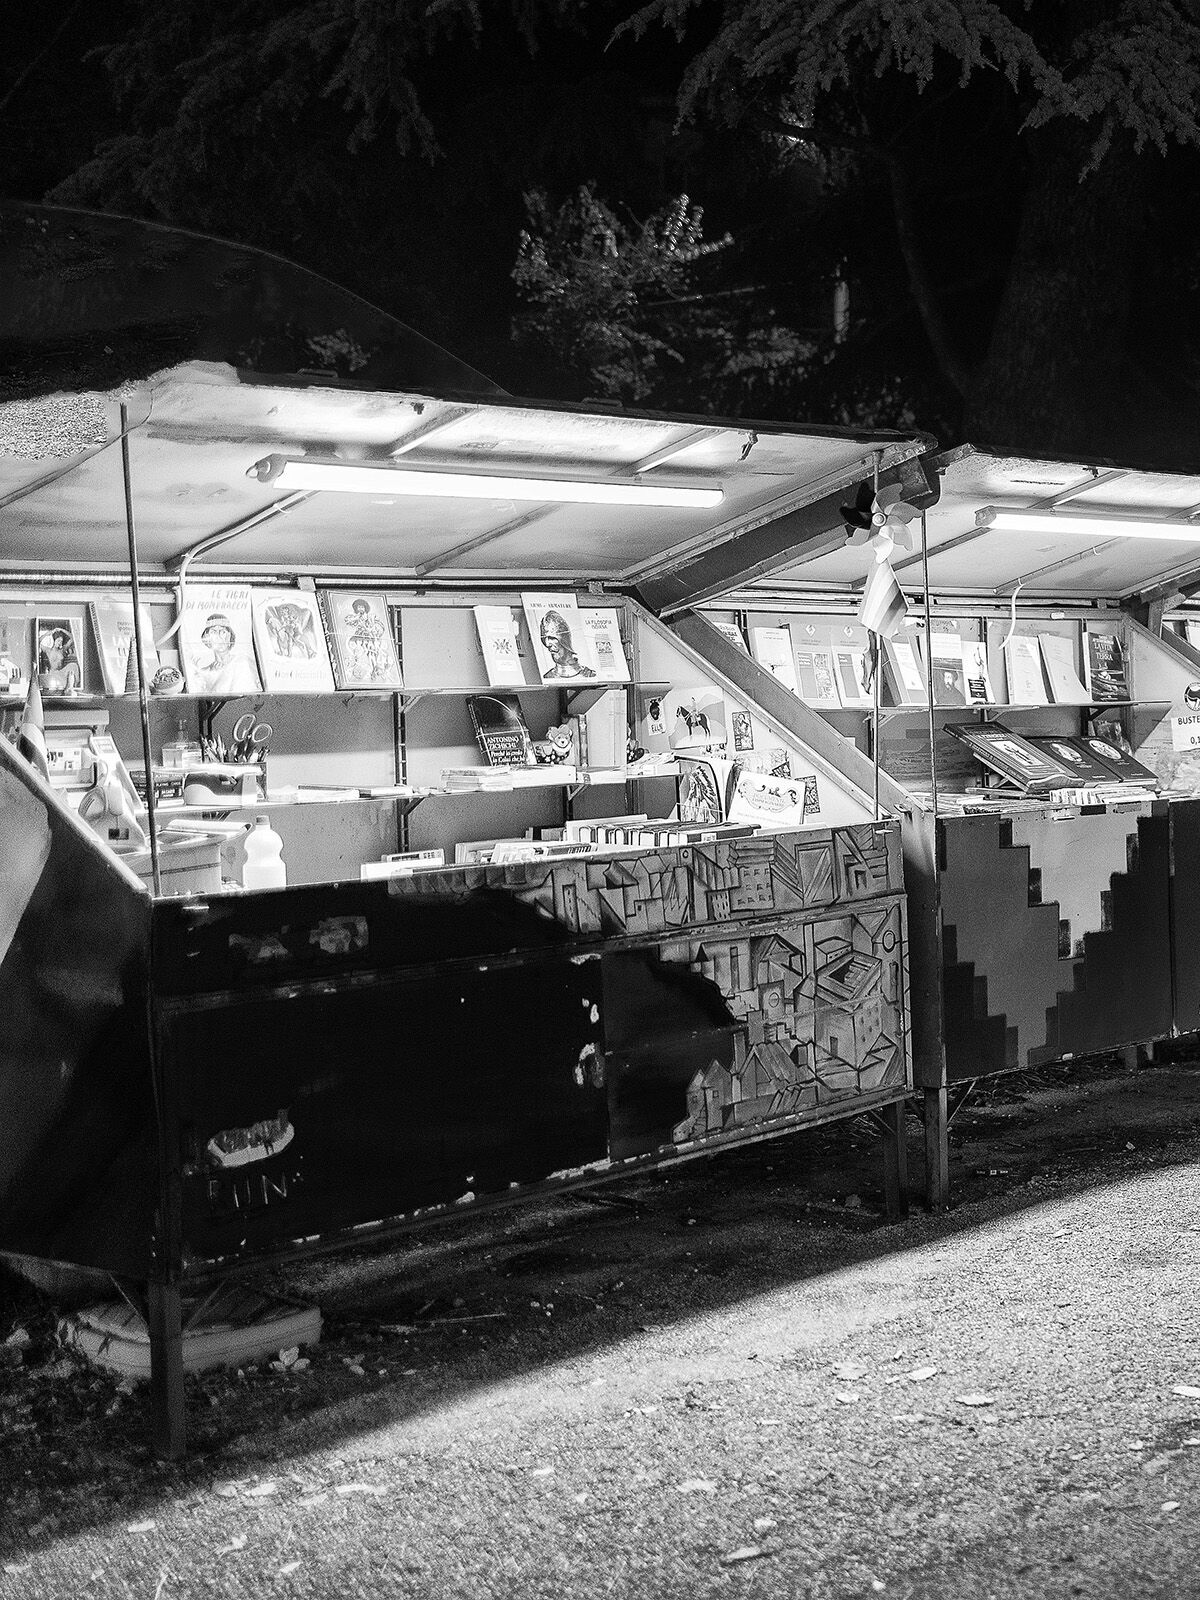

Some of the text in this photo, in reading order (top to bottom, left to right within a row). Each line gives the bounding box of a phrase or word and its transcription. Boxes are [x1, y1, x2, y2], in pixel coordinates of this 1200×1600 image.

[226, 590, 249, 600] TIGRI
[1177, 715, 1200, 726] BUSTE
[487, 735, 520, 744] ANTONINO
